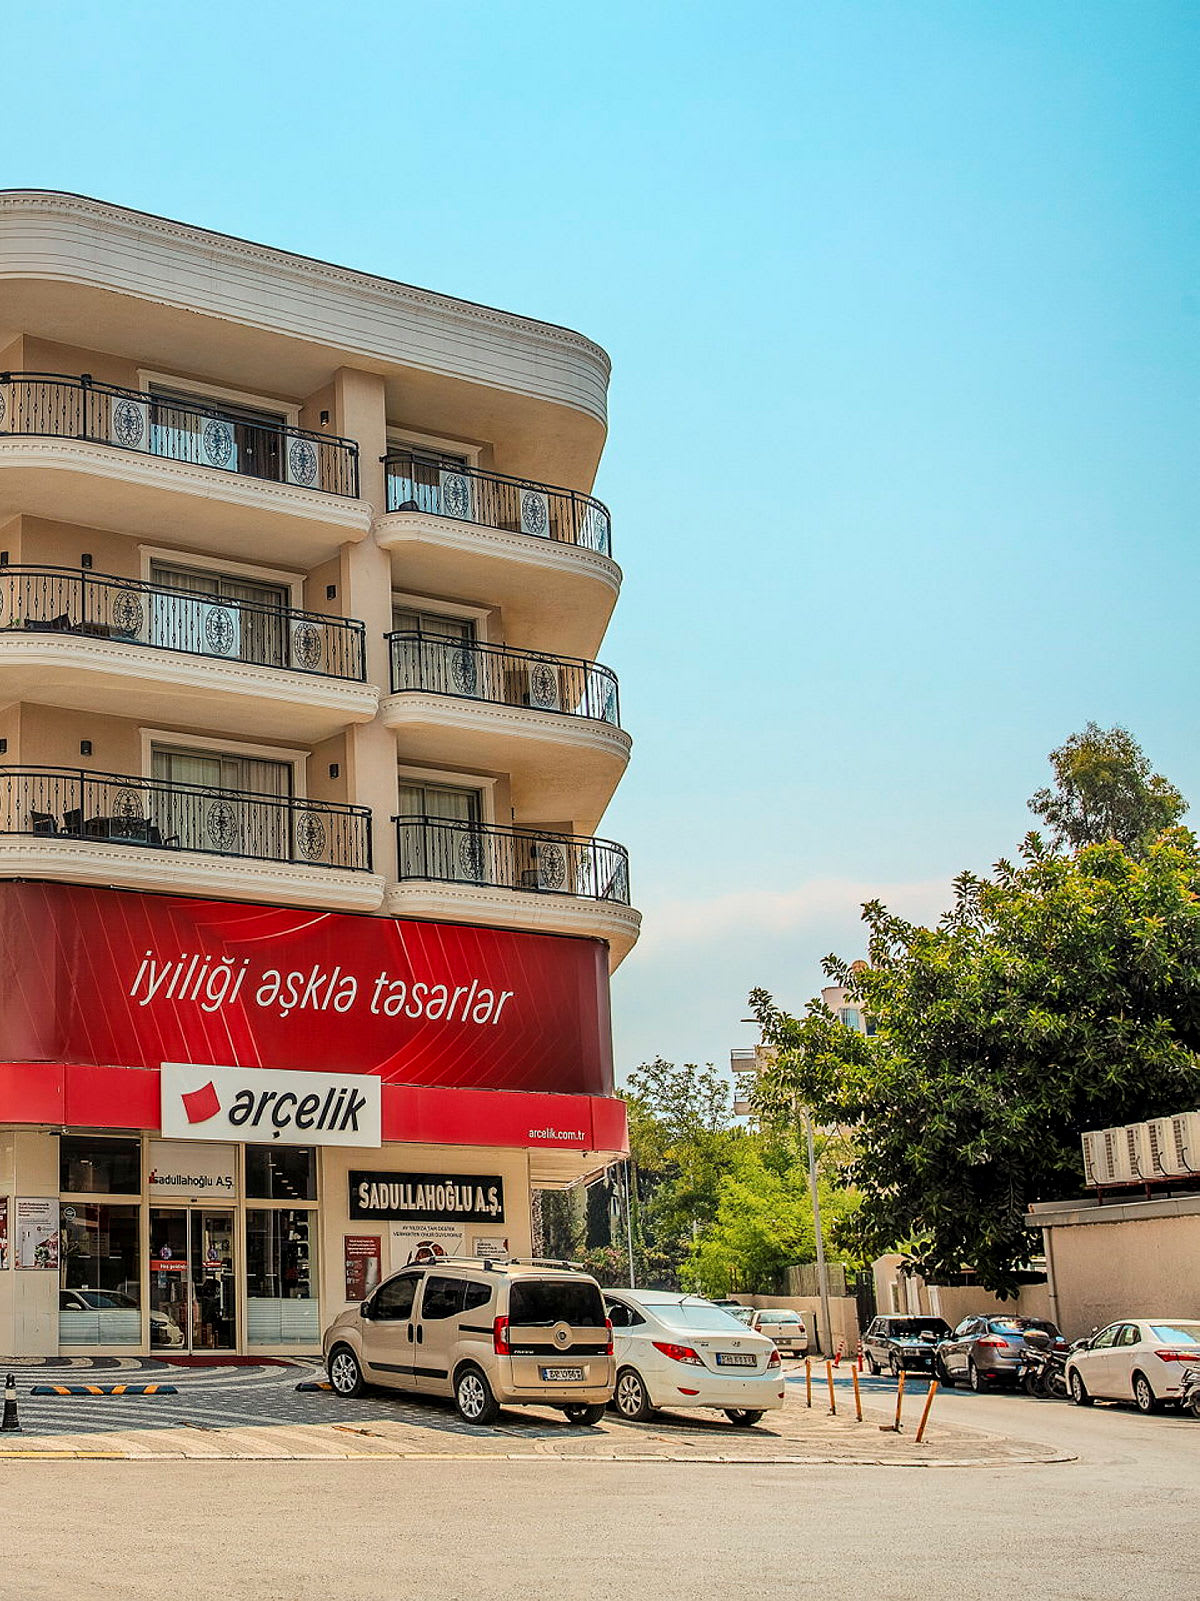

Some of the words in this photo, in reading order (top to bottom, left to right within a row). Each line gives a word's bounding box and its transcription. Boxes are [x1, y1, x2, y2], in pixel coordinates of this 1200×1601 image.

[130, 950, 250, 1013] iyiliği
[256, 963, 358, 1018] aşkla
[370, 971, 515, 1025] tasarlar
[228, 1087, 367, 1139] arçelik
[528, 1127, 585, 1141] arcelik.com.tr
[153, 1174, 213, 1188] sadullahoğlu
[358, 1180, 473, 1212] SADULLAHOĞLU
[474, 1186, 502, 1216] A.Ş.
